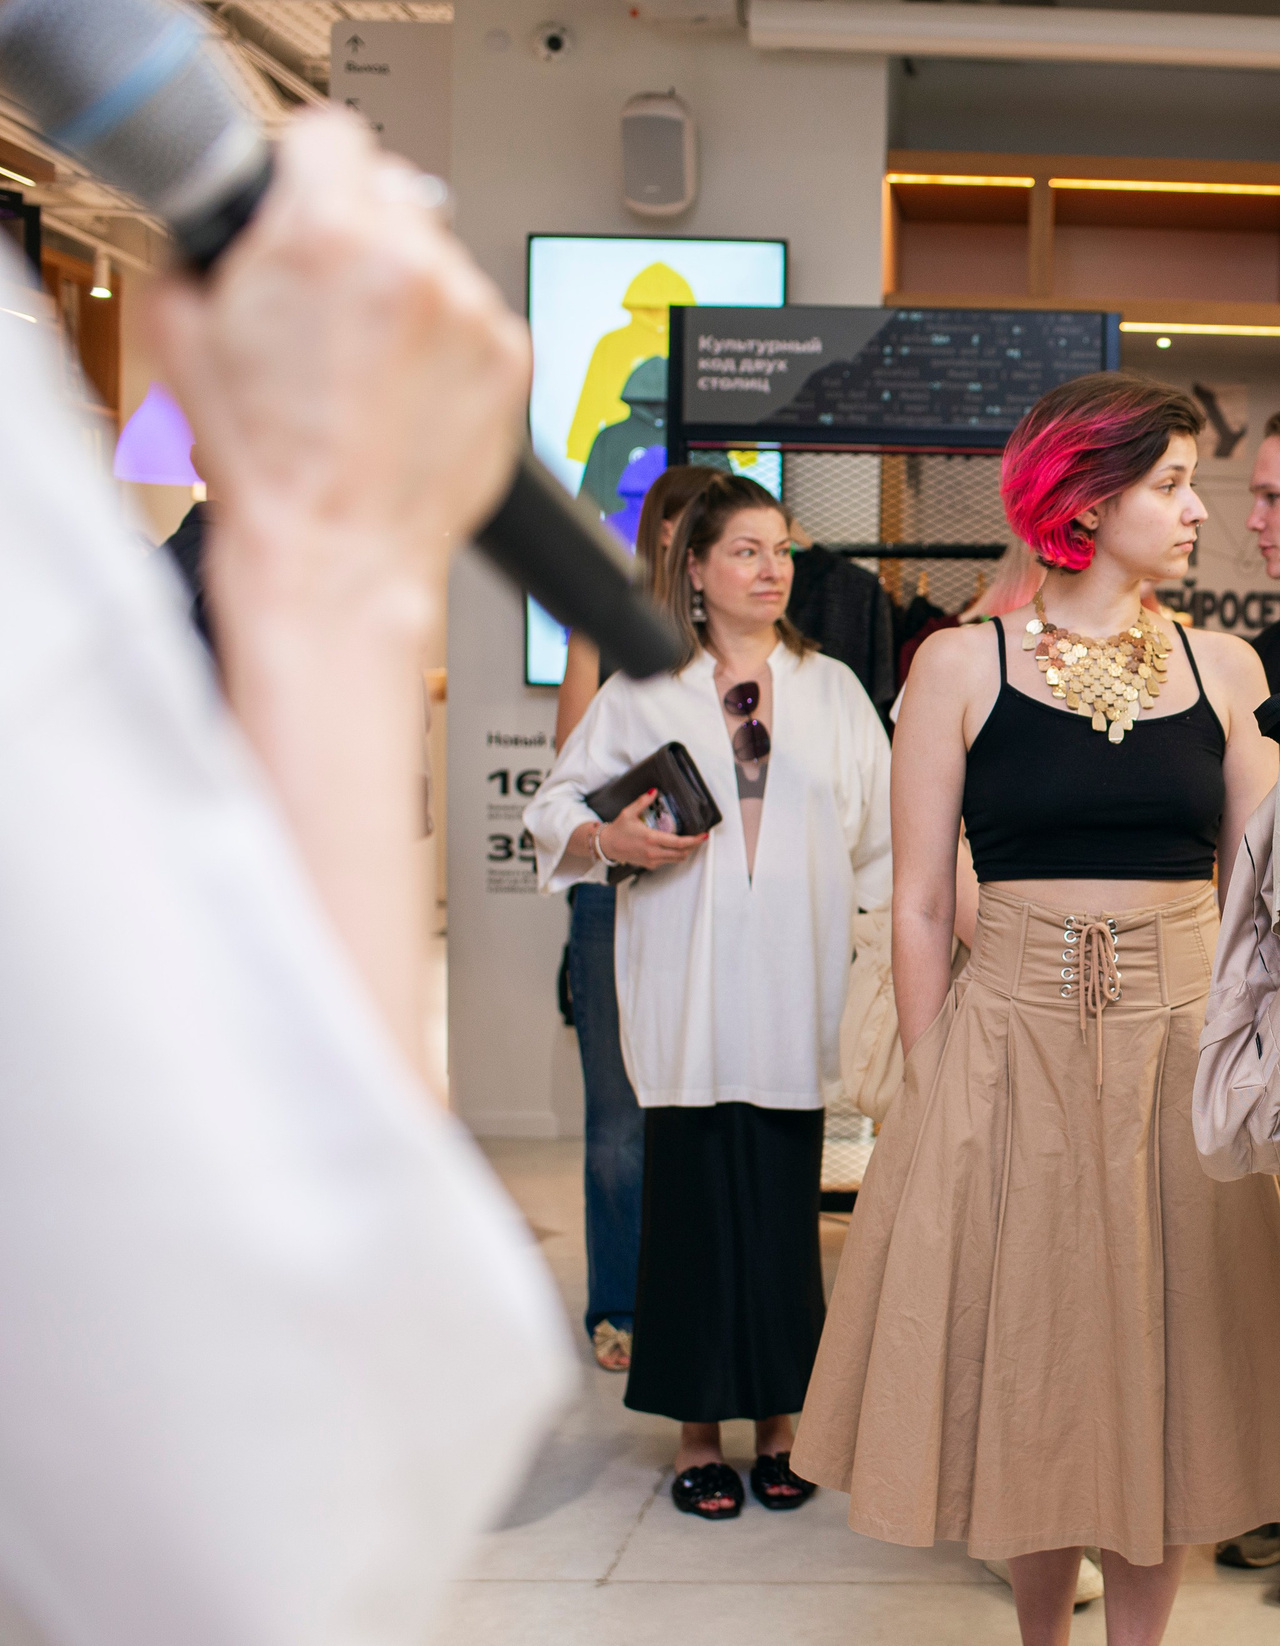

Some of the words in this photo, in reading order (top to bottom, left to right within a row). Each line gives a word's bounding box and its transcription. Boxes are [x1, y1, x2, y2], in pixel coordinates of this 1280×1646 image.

[698, 334, 823, 356] Культурный
[698, 357, 737, 374] код
[739, 358, 789, 375] двух
[697, 376, 771, 394] столиц
[487, 731, 546, 747] Новый
[487, 768, 552, 796] 16
